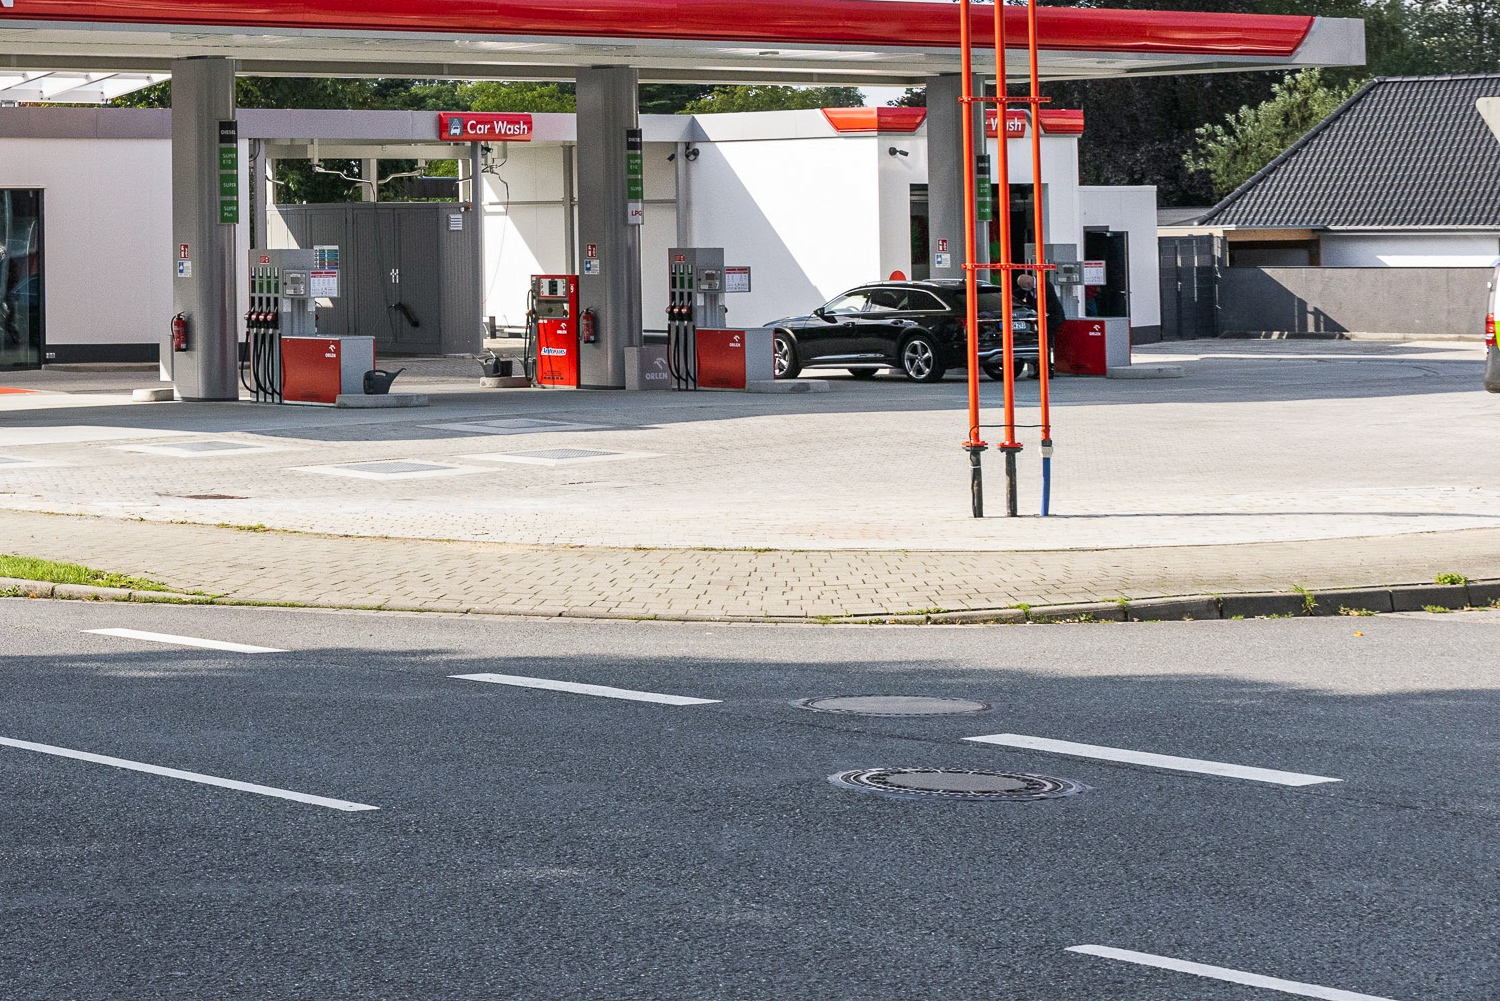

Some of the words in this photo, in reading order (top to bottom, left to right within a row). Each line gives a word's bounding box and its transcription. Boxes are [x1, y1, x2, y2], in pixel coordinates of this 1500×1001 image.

[467, 120, 491, 134] Car
[493, 120, 528, 135] Wash
[990, 117, 1022, 131] Wsh
[715, 281, 720, 289] 7
[645, 372, 668, 380] ORLEN
